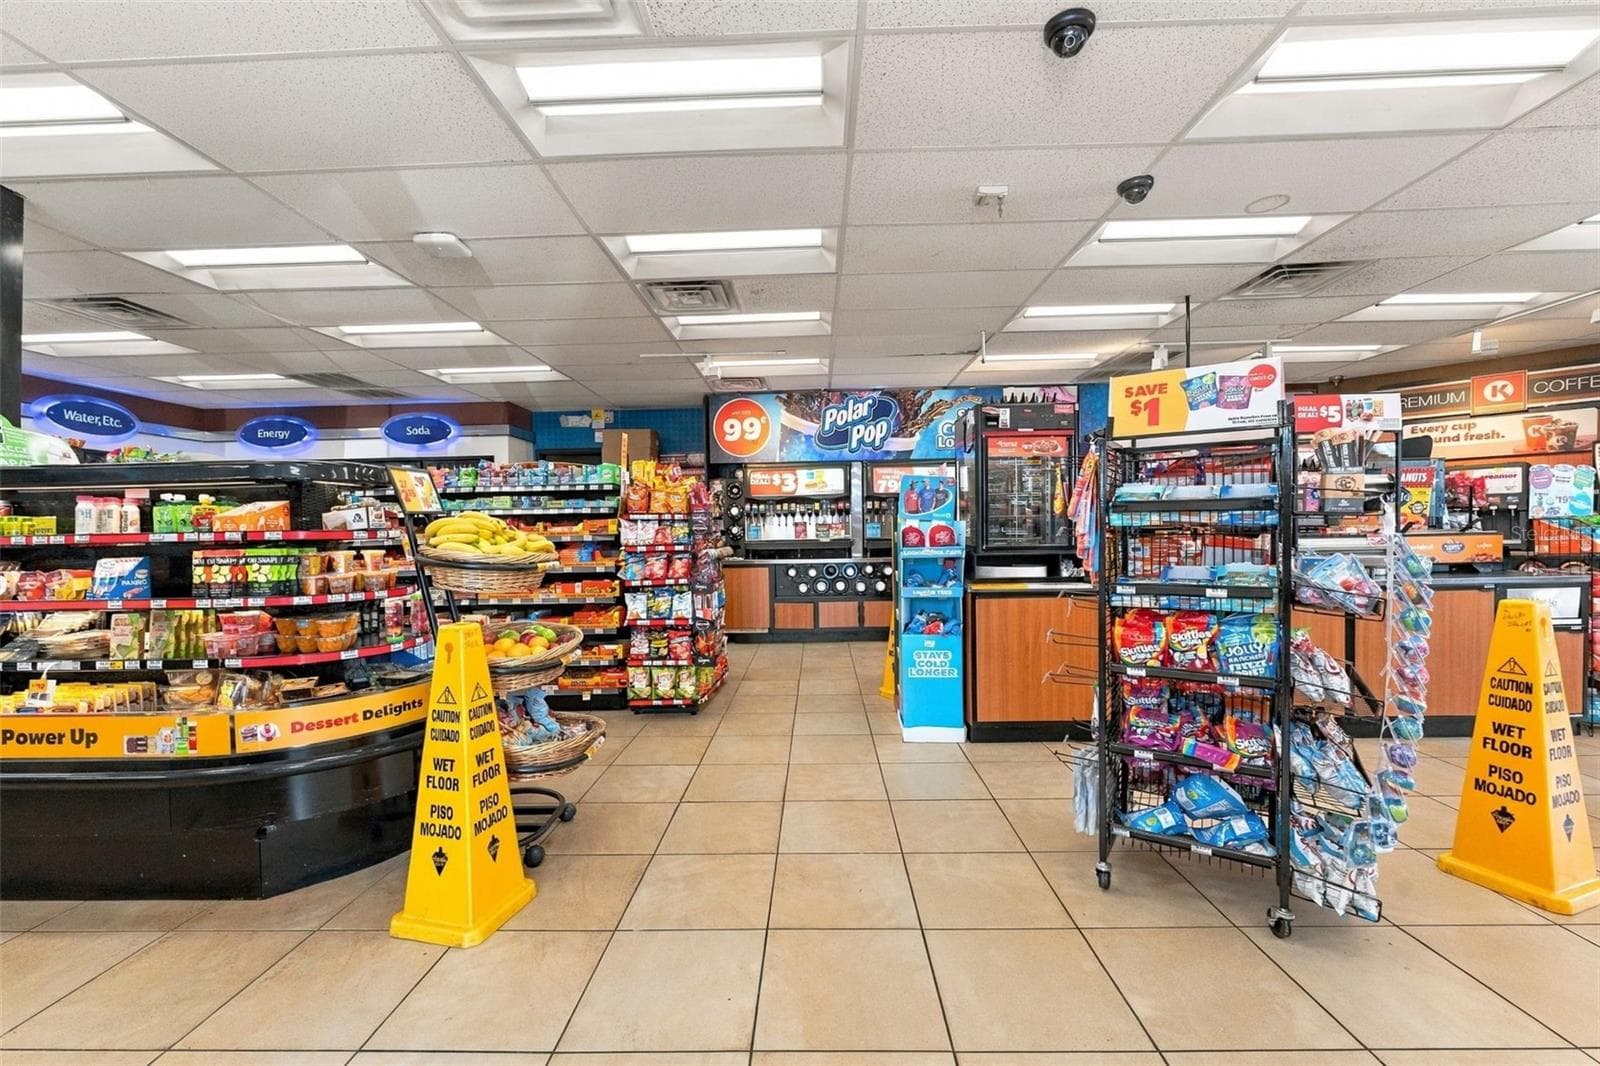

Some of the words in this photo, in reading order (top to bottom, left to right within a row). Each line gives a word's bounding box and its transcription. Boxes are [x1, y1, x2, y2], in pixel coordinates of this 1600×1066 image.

[1124, 382, 1168, 399] SAVE
[1533, 374, 1600, 395] COFFE
[1401, 390, 1466, 409] REMIUM
[63, 408, 103, 427] Water,
[102, 415, 123, 428] Etc.
[824, 399, 873, 432] Polar
[1130, 398, 1161, 427] $1
[1320, 405, 1341, 423] $5
[257, 428, 291, 439] Energy
[406, 426, 431, 436] Soda
[723, 415, 767, 442] 99¢
[851, 421, 888, 449] Pop
[1411, 421, 1449, 434] Every
[1451, 421, 1477, 433] cup
[1433, 432, 1461, 444] und
[1464, 428, 1505, 442] fresh.
[772, 473, 798, 492] $3
[877, 479, 899, 491] 79
[1400, 472, 1427, 482] ANUTS
[1170, 630, 1213, 643] Skittles
[915, 651, 951, 660] STAYS
[1120, 644, 1158, 658] Skittles
[1226, 640, 1264, 658] JOLLY
[908, 668, 956, 677] LONGER
[917, 660, 948, 669] COLD
[1490, 676, 1534, 695] CAUTION
[1543, 680, 1563, 696] CAUTION
[468, 702, 494, 722] CAUTION
[1488, 693, 1533, 713] CUIDADO
[1545, 698, 1565, 715] CUIDADO
[290, 711, 359, 735] Dessert
[362, 697, 424, 723] Delights
[431, 708, 461, 724] CAUTION
[1, 728, 66, 747] Power
[69, 727, 99, 748] Up
[430, 728, 460, 744] CUIDADO
[469, 720, 496, 741] CUIDADO
[1491, 721, 1526, 740] WET
[1550, 727, 1566, 743] WET
[475, 747, 495, 768] WET
[1482, 737, 1533, 760] FLOOR
[1549, 745, 1572, 762] FLOOR
[433, 757, 455, 773] WET
[426, 774, 460, 792] FLOOR
[472, 764, 501, 788] FLOOR
[1488, 764, 1524, 785] PISO
[1555, 773, 1572, 790] PISO
[1474, 777, 1537, 806] MOJADO
[1552, 790, 1580, 809] MOJADO
[430, 803, 454, 821] PISO
[480, 792, 499, 815] PISO
[474, 805, 508, 837] MOJADO
[420, 821, 462, 841] MOJADO
